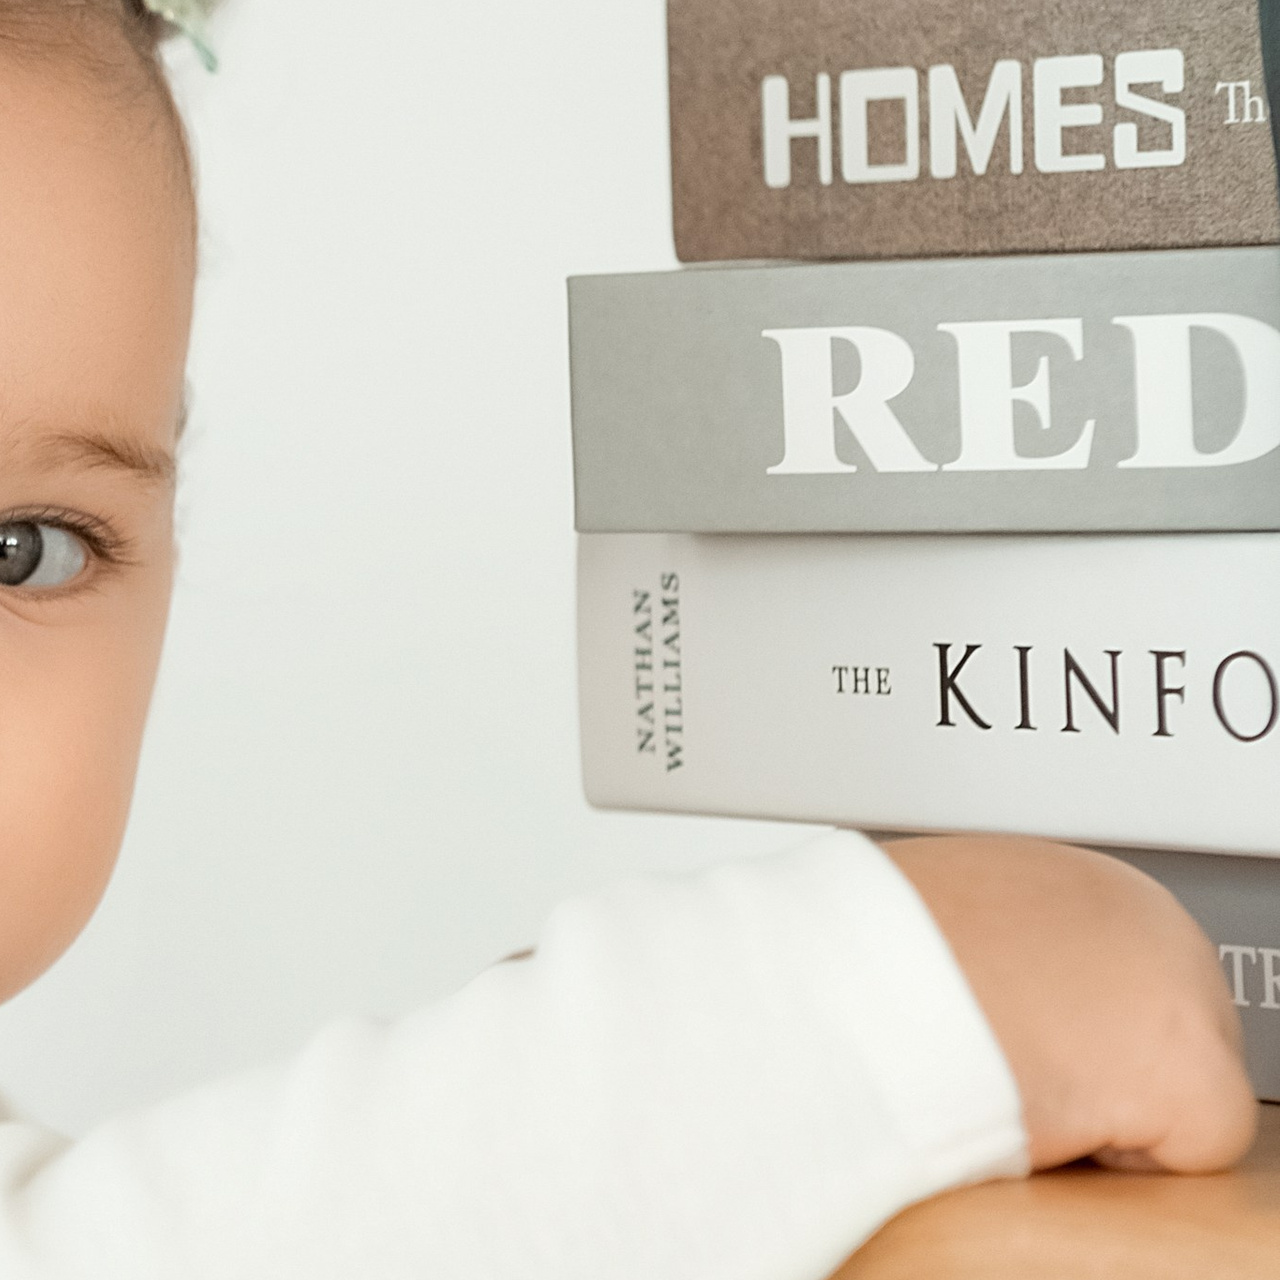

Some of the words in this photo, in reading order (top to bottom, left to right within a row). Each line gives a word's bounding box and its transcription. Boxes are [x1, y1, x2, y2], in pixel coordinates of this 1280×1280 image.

[762, 48, 1186, 188] HOMES
[1215, 80, 1267, 125] Th
[761, 312, 1280, 475] RED
[633, 588, 656, 754] NATHAN
[661, 572, 683, 772] WILLIAMS
[832, 665, 892, 696] THE
[933, 642, 1280, 743] KINFO
